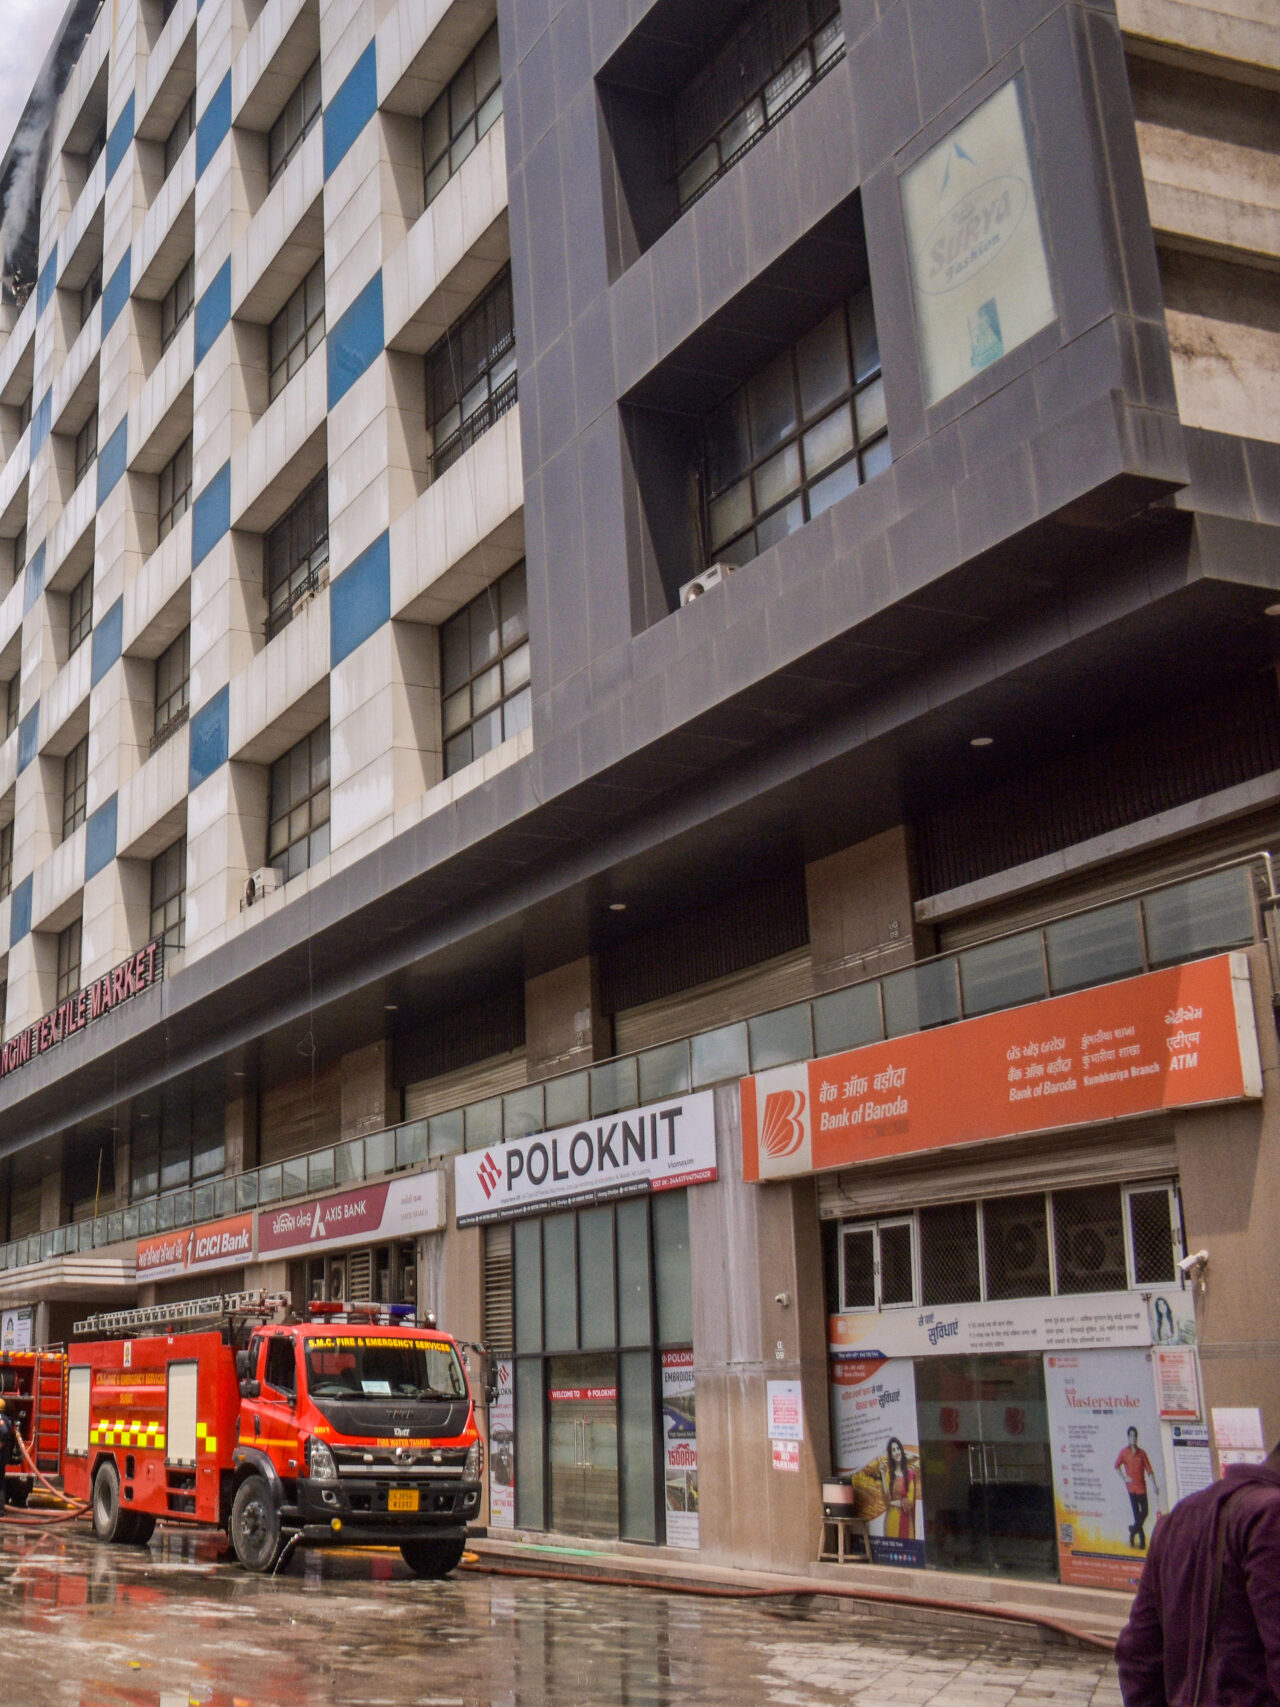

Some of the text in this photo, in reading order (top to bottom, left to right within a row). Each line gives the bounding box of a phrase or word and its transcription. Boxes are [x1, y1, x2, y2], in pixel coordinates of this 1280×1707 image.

[34, 989, 87, 1054] TEXTILE
[90, 942, 158, 1020] MARKET
[1131, 1062, 1160, 1077] Branch
[1169, 1052, 1199, 1072] ATM
[819, 1080, 838, 1103] बैंक
[873, 1064, 907, 1093] बड़ौदा
[1009, 1077, 1077, 1101] Bank of Baroda
[820, 1095, 908, 1131] Bank of Baroda
[506, 1106, 683, 1191] POLOKNIT
[324, 1200, 366, 1222] AXIS BANK
[195, 1228, 249, 1258] ICICI Bank
[918, 1315, 924, 1327] से
[928, 1318, 959, 1346] सुविधाएं
[308, 1337, 451, 1352] S.M.C. FIRE & EMERGENCY SERVICES
[552, 1388, 616, 1398] WELCOME TO POLOKNIT
[1065, 1394, 1141, 1409] Masterstroke
[376, 1438, 431, 1447] FIRE WATER TANKER
[668, 1450, 697, 1467] 1500RP
[773, 1460, 799, 1470] PARKING
[781, 1451, 790, 1461] NO
